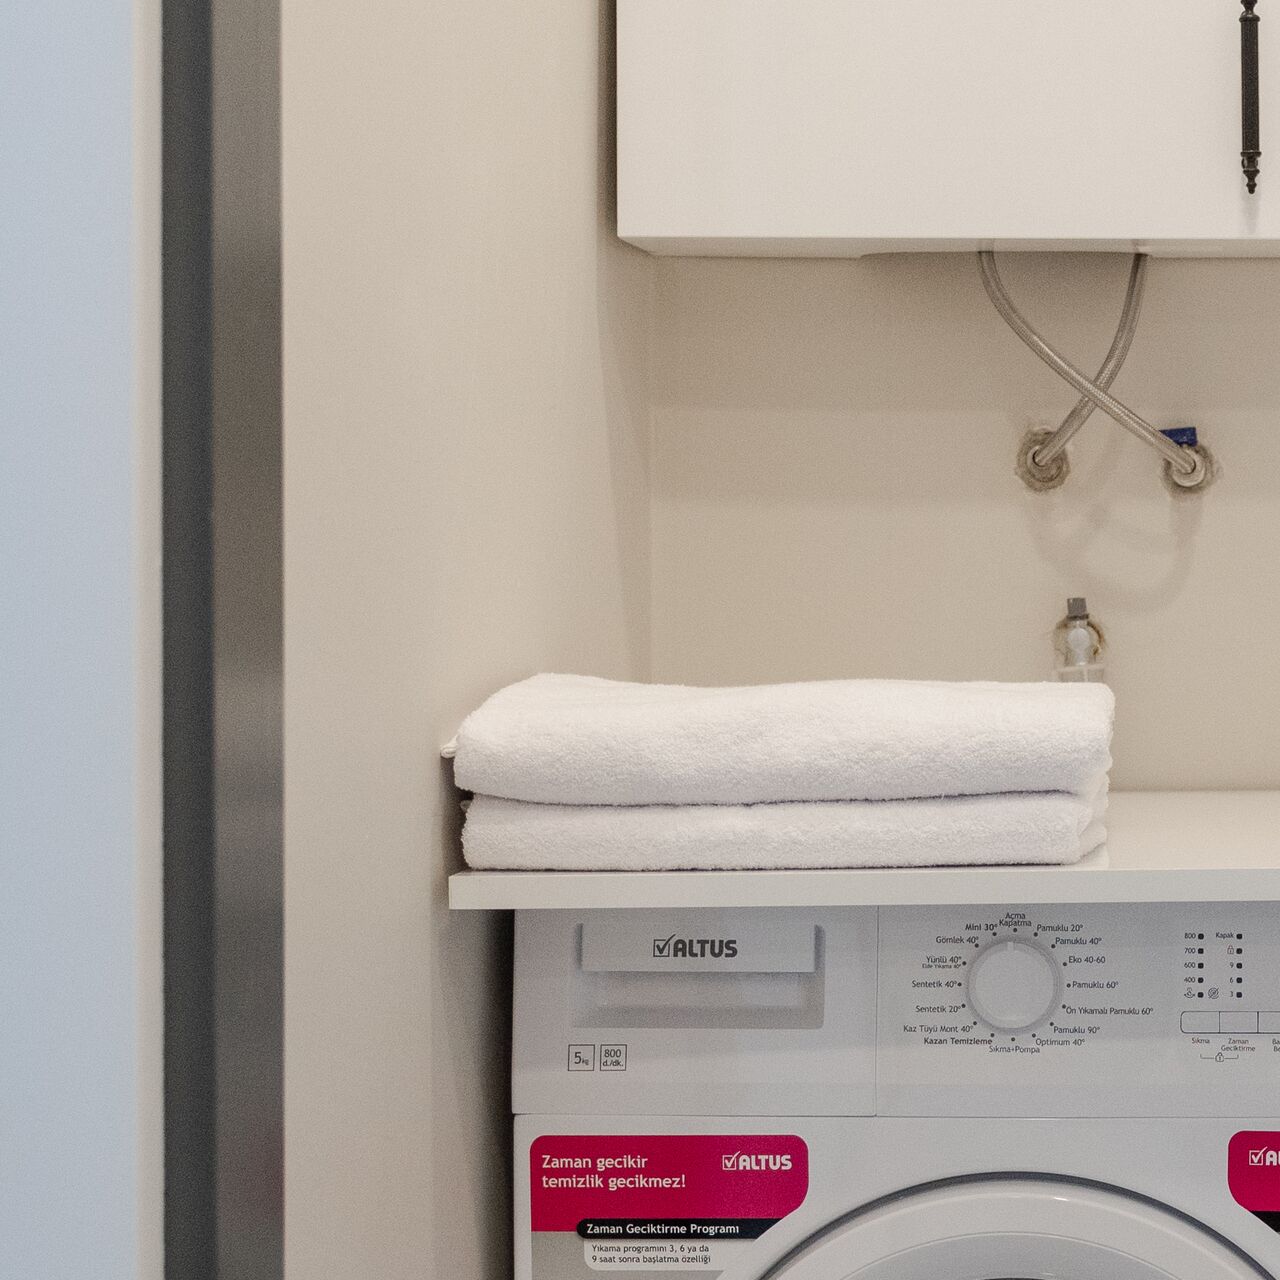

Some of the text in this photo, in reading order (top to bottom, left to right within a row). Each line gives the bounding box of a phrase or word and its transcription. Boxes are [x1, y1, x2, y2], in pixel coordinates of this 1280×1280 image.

[1005, 912, 1026, 920] Açma
[965, 923, 981, 931] Mini
[999, 919, 1032, 927] Kapatma
[1037, 924, 1069, 932] Pamuklu
[1055, 937, 1087, 945] Pamuklu
[673, 939, 738, 958] ALTUS
[912, 980, 942, 988] Sentetik
[915, 1005, 946, 1013] Sentetik
[1066, 1006, 1077, 1014] Ön
[1109, 1007, 1139, 1015] Pamuklu
[919, 1025, 938, 1034] Tüyü
[924, 1037, 948, 1045] Kazan
[1036, 1038, 1070, 1046] Optimum
[604, 1048, 621, 1058] 800
[989, 1045, 1040, 1053] Sıkma+Pompa
[542, 1154, 648, 1172] Zaman gecikir
[739, 1154, 793, 1170] ALTUS
[541, 1173, 686, 1191] temizlik gecikmez!
[586, 1223, 739, 1236] Zaman Geciktirme Programı
[592, 1244, 709, 1255] Yıkama programını 3, 6 ya da
[592, 1255, 597, 1263] 9
[643, 1255, 679, 1265] başlatma
[682, 1255, 711, 1265] özelliği
